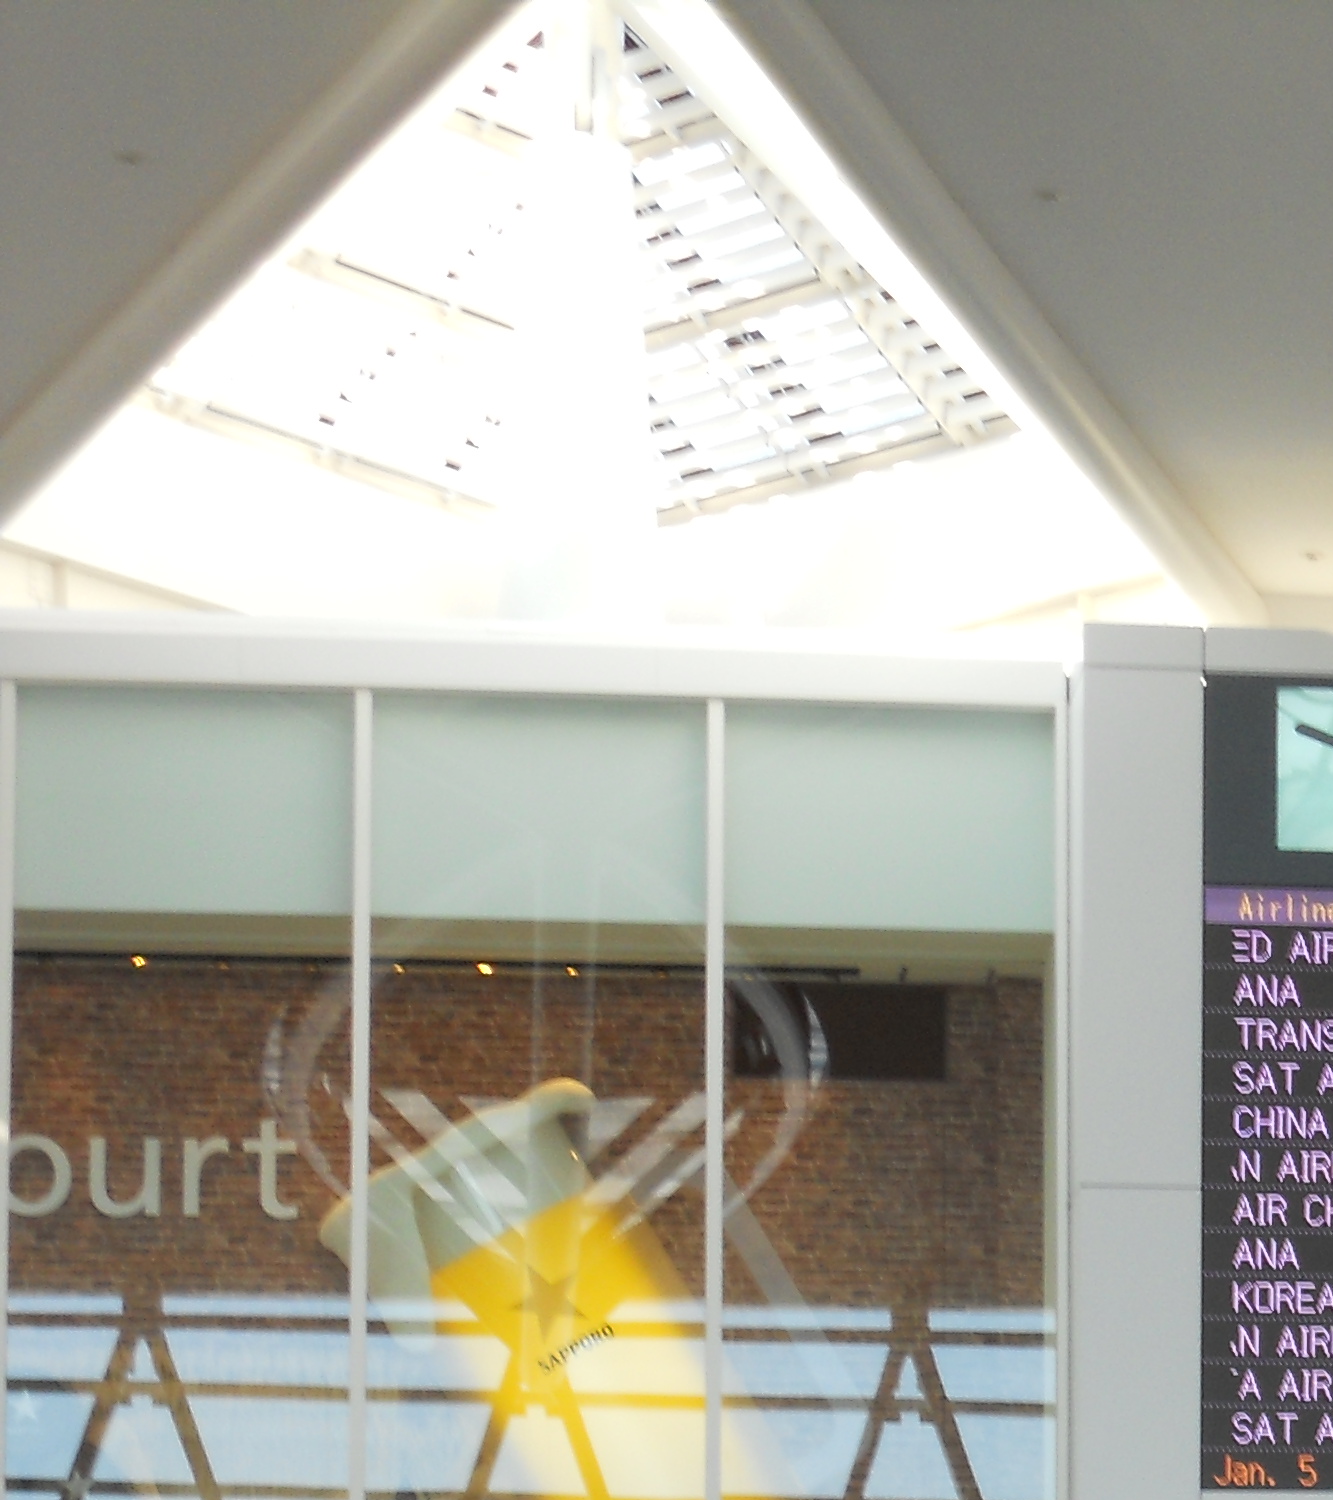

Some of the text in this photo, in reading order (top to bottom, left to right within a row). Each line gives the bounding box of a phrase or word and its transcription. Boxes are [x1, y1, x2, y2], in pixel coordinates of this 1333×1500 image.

[1233, 974, 1301, 1007] ANA
[1232, 1061, 1300, 1096] SAT
[1232, 1105, 1330, 1140] CHINA
[1230, 1149, 1261, 1183] N
[1231, 1193, 1288, 1227] AIR
[1231, 1237, 1300, 1270] ANA
[536, 1321, 615, 1376] SAPPORO
[1229, 1324, 1260, 1358] N
[1230, 1367, 1262, 1401] A
[1277, 1369, 1333, 1402] AIR
[1231, 1412, 1299, 1446] SAT
[1213, 1454, 1277, 1488] Jan.
[1297, 1453, 1320, 1488] 5
